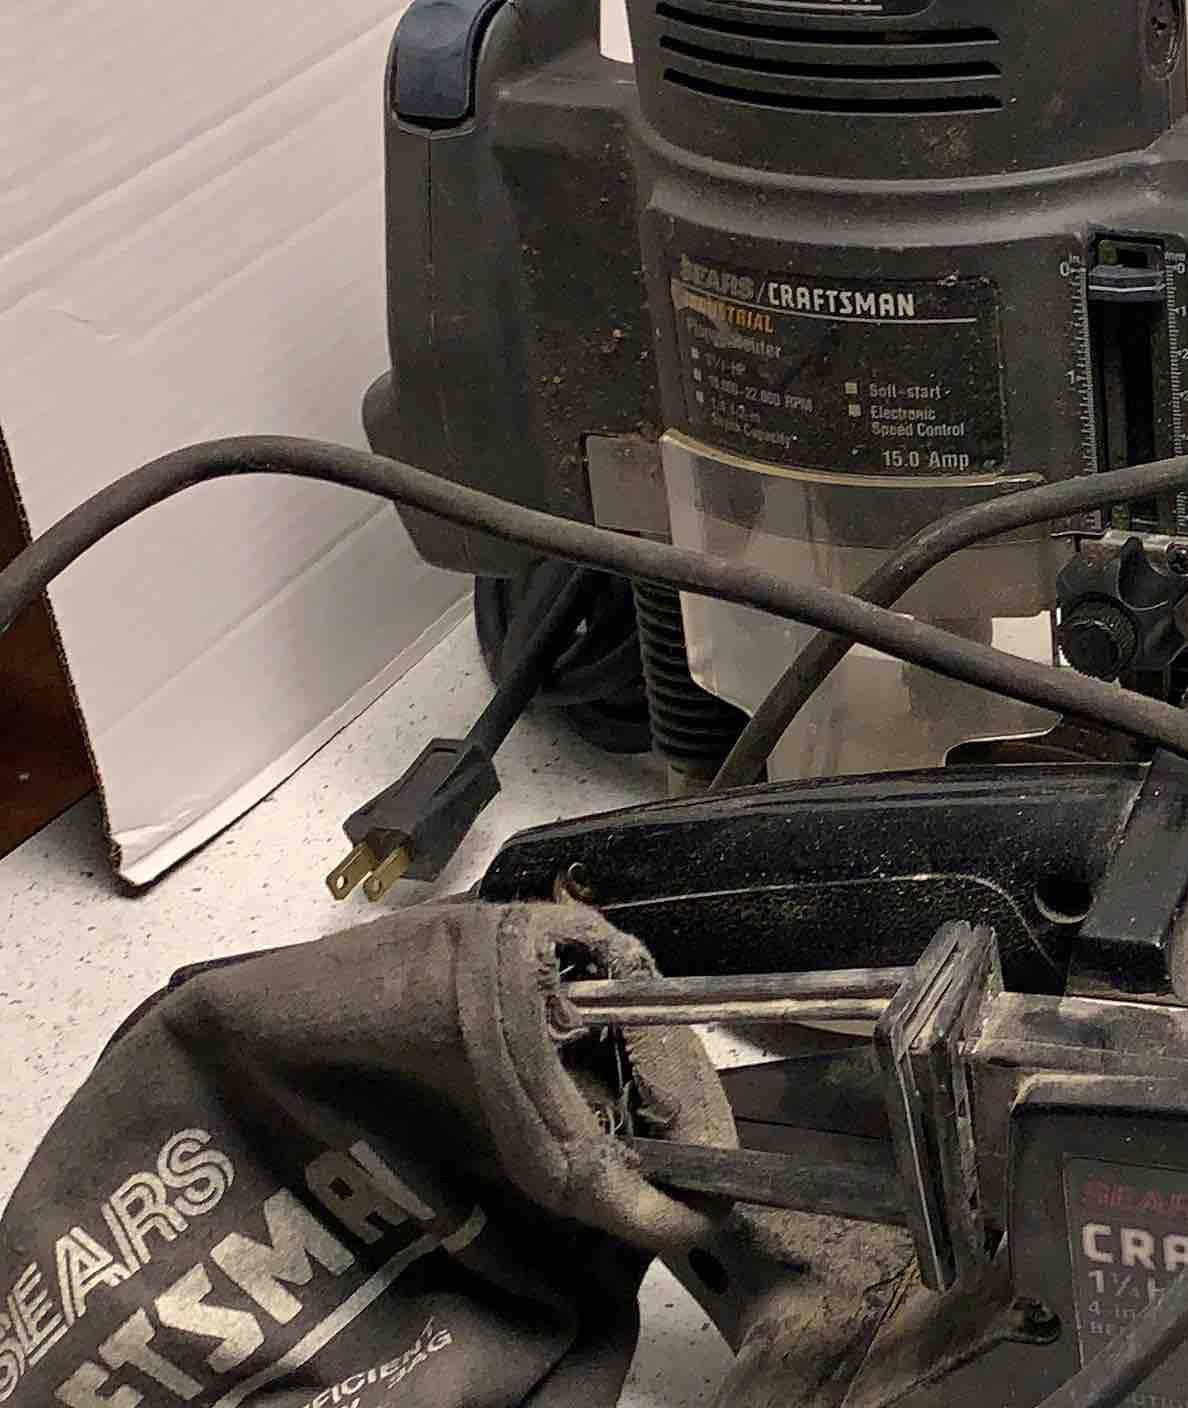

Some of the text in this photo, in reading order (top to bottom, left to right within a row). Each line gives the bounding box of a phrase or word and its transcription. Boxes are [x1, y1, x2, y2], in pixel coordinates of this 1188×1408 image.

[870, 404, 937, 421] Electronic
[871, 421, 965, 438] Speed Control
[882, 449, 969, 471] 15.0 Amp
[0, 1127, 235, 1402] SEARS
